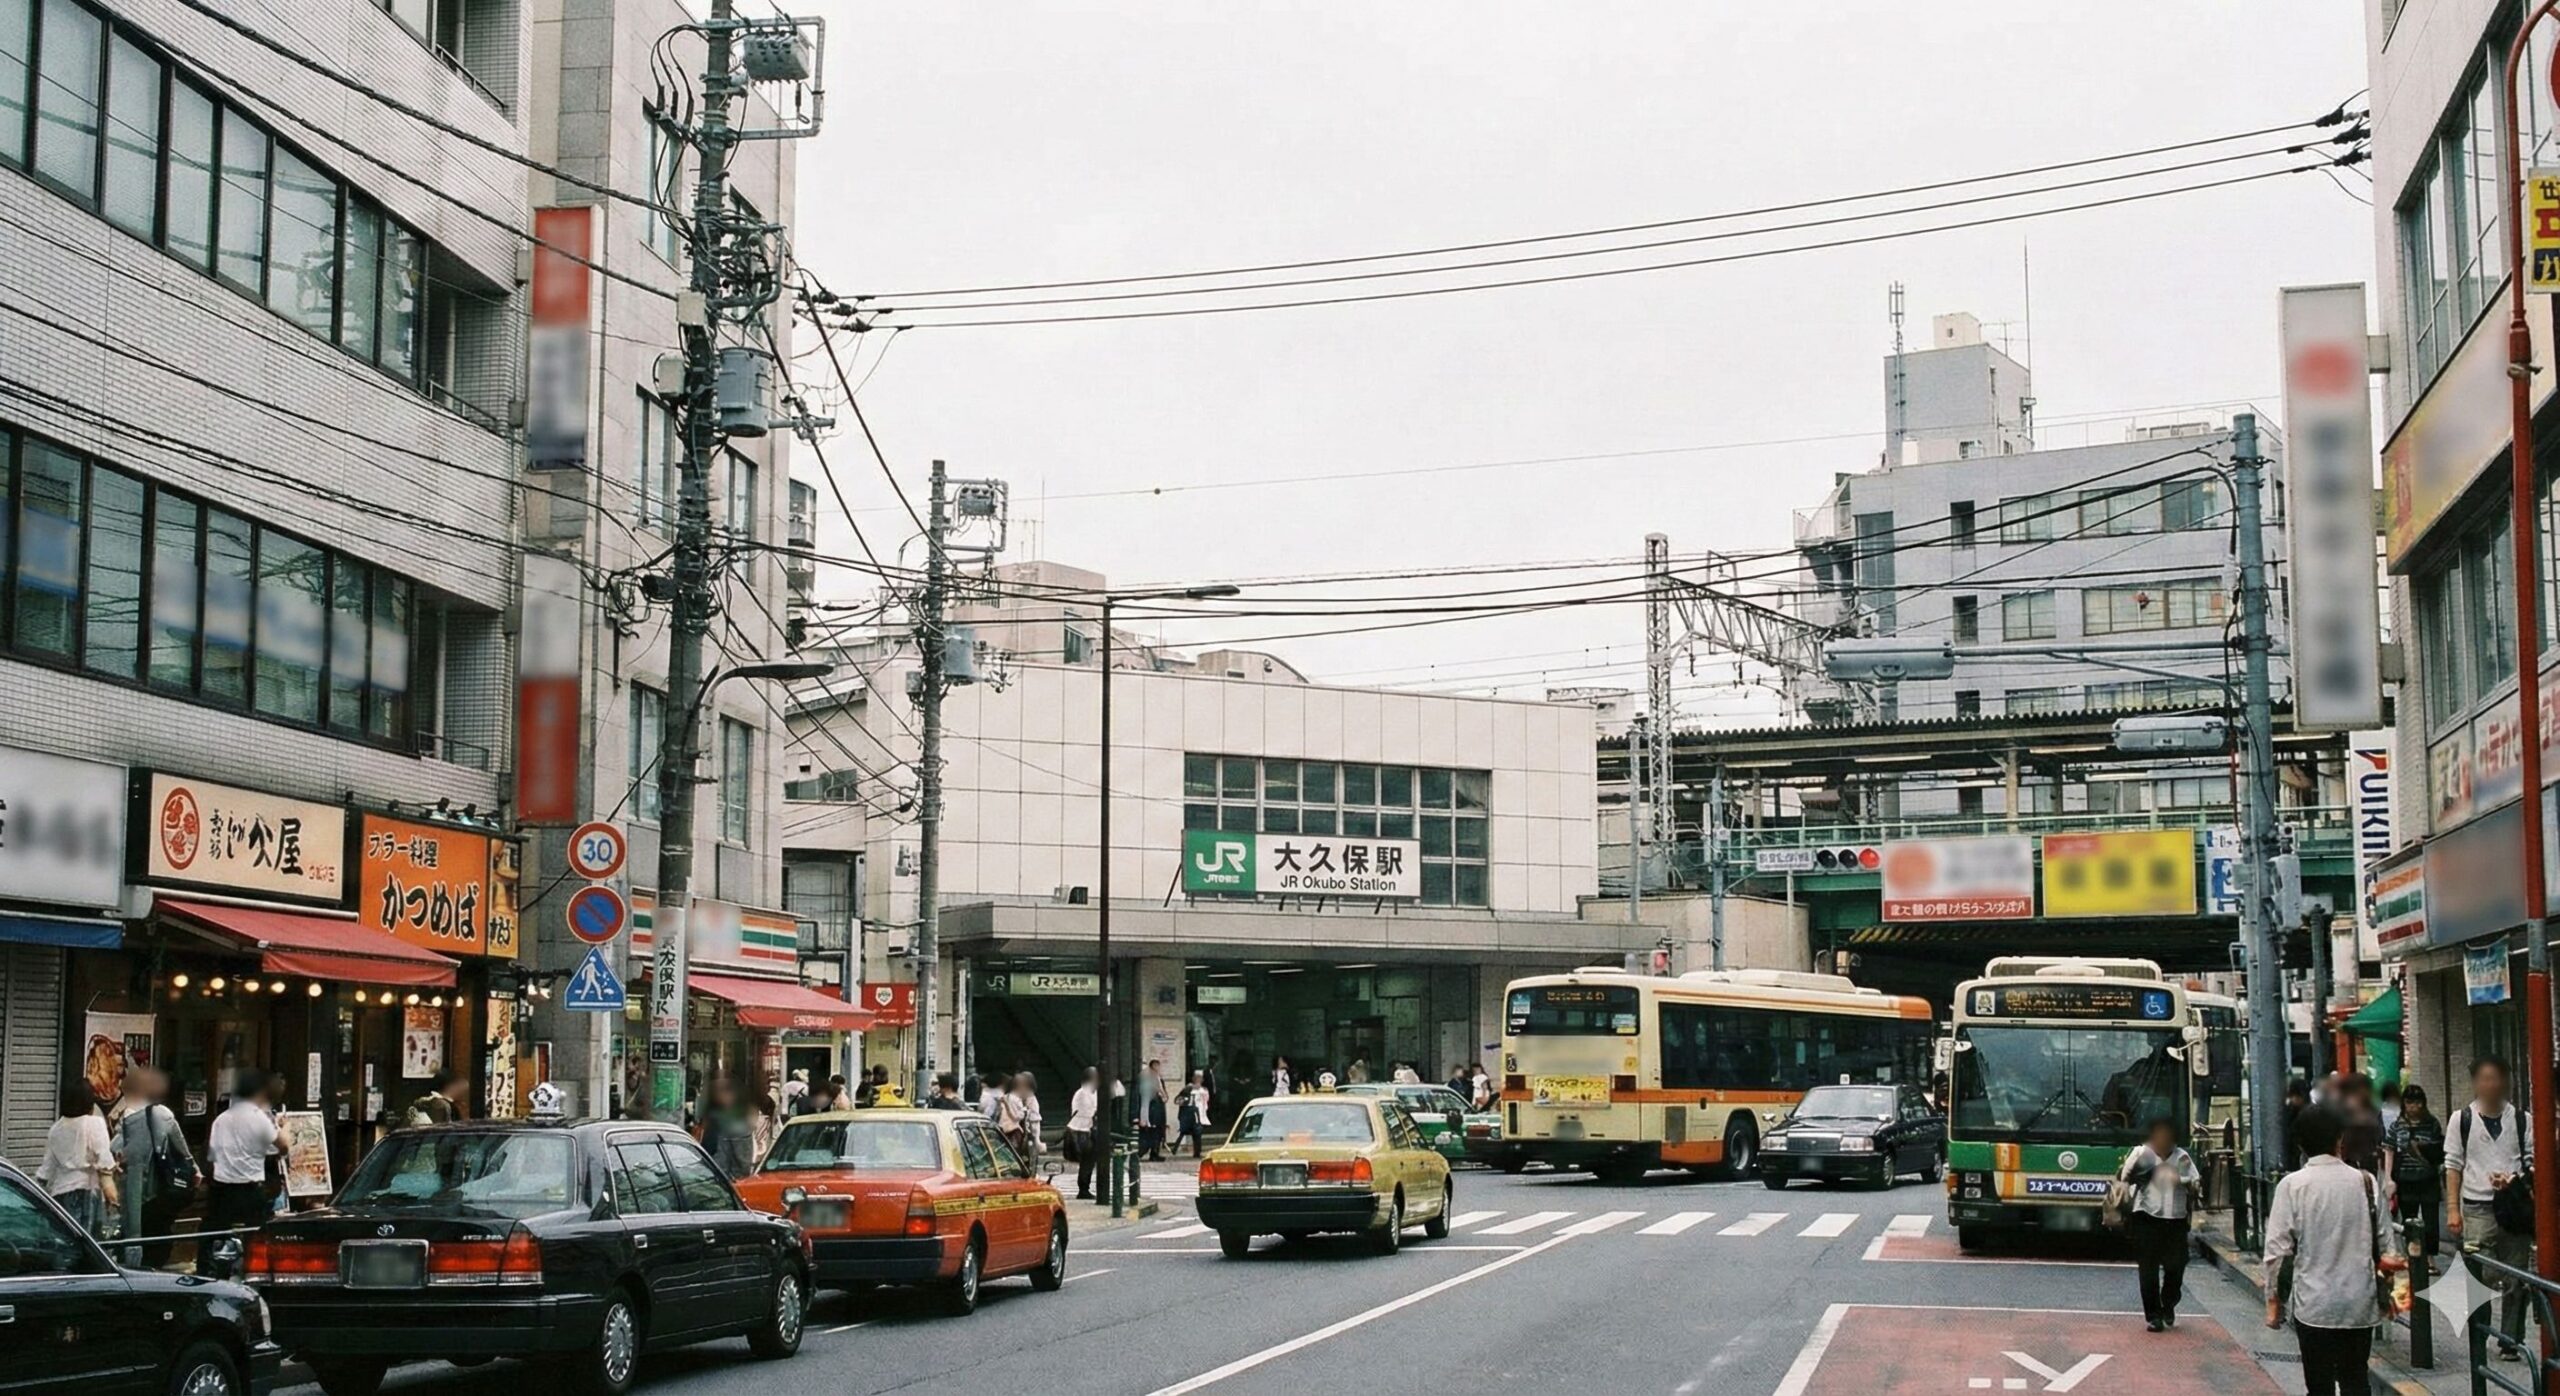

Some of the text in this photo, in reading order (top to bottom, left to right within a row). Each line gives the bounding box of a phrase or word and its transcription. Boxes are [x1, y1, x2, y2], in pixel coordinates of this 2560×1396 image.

[582, 838, 613, 864] 30
[1195, 841, 1247, 873] JR
[1274, 841, 1403, 876] 大久保駅
[1280, 875, 1396, 891] JR Okubo Station
[381, 873, 480, 940] かつめば
[1032, 976, 1051, 987] JR
